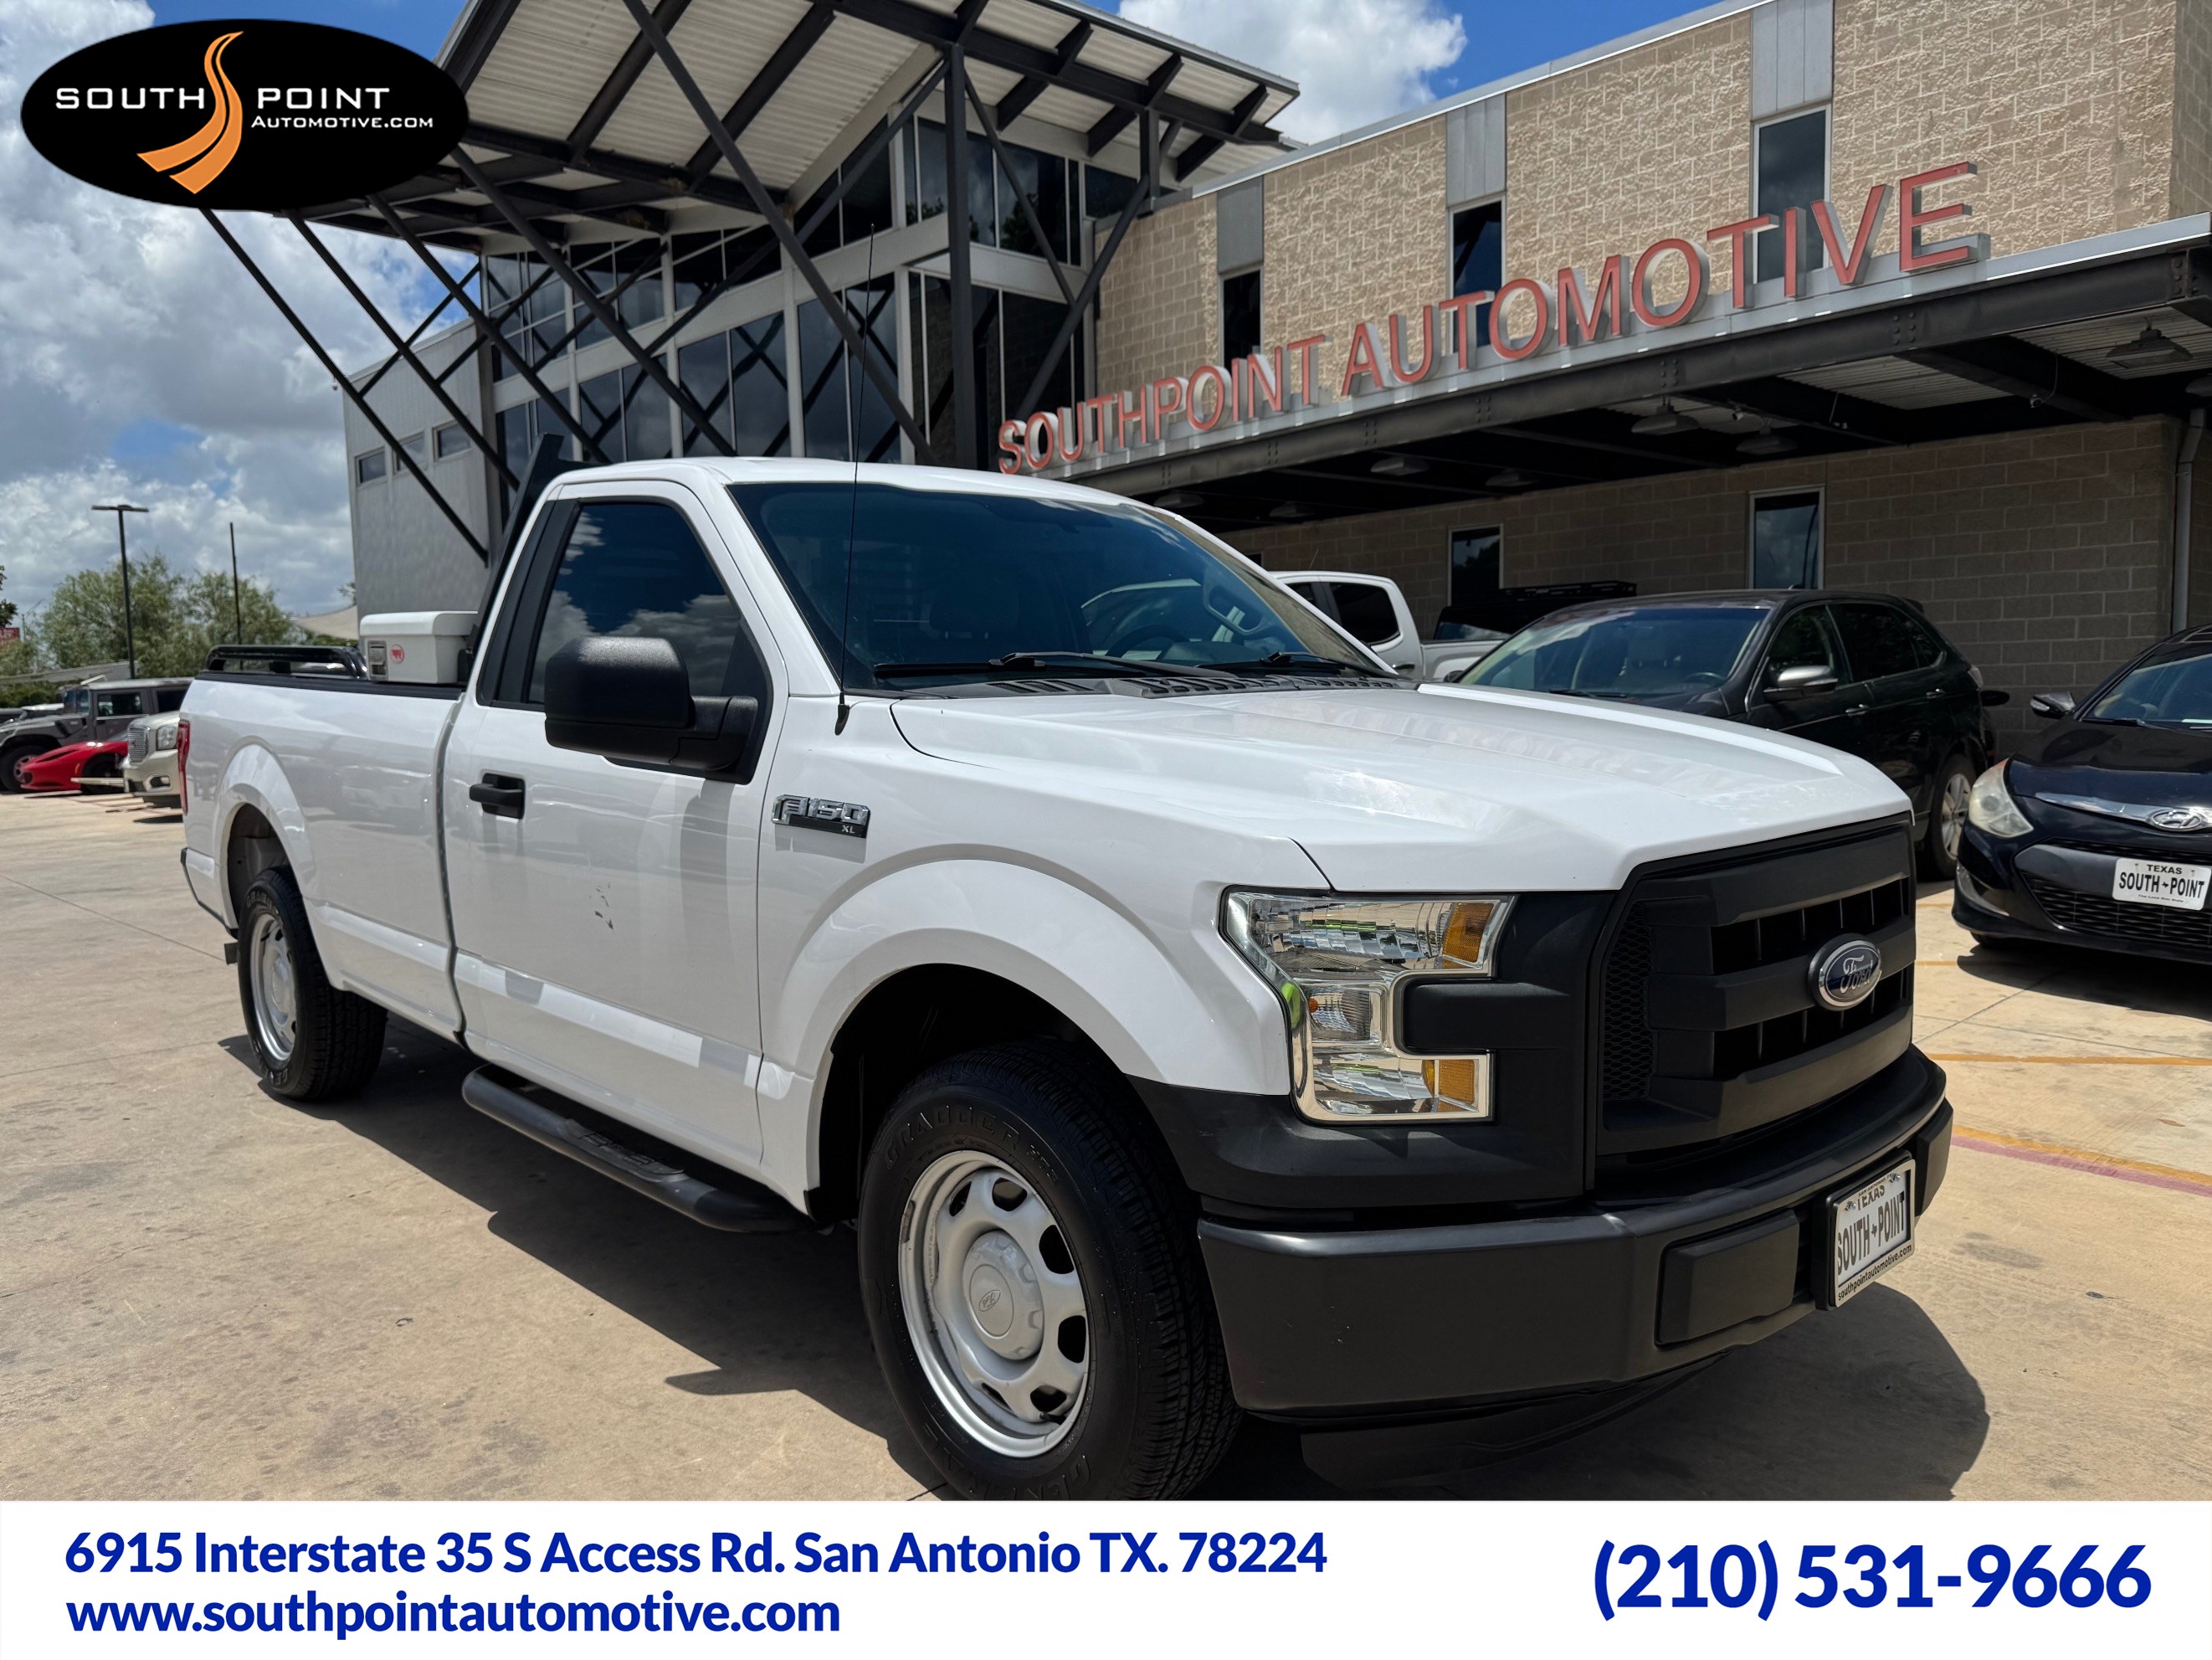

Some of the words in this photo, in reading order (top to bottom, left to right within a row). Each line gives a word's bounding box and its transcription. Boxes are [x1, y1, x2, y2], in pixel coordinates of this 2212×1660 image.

[998, 334, 1329, 475] SOUTHPOINT
[1341, 162, 1987, 397] AUTOMOTIVE
[841, 825, 855, 834] XL
[2119, 872, 2160, 892] SOUTH
[2169, 877, 2205, 898] POINT
[2147, 864, 2183, 875] TEXAS
[1840, 954, 1873, 994] Ford
[1857, 1185, 1886, 1210] TEXAS
[1838, 1214, 1870, 1276] SOUTH
[1878, 1191, 1905, 1247] POINT
[1838, 1244, 1912, 1301] southpointautomotive.com
